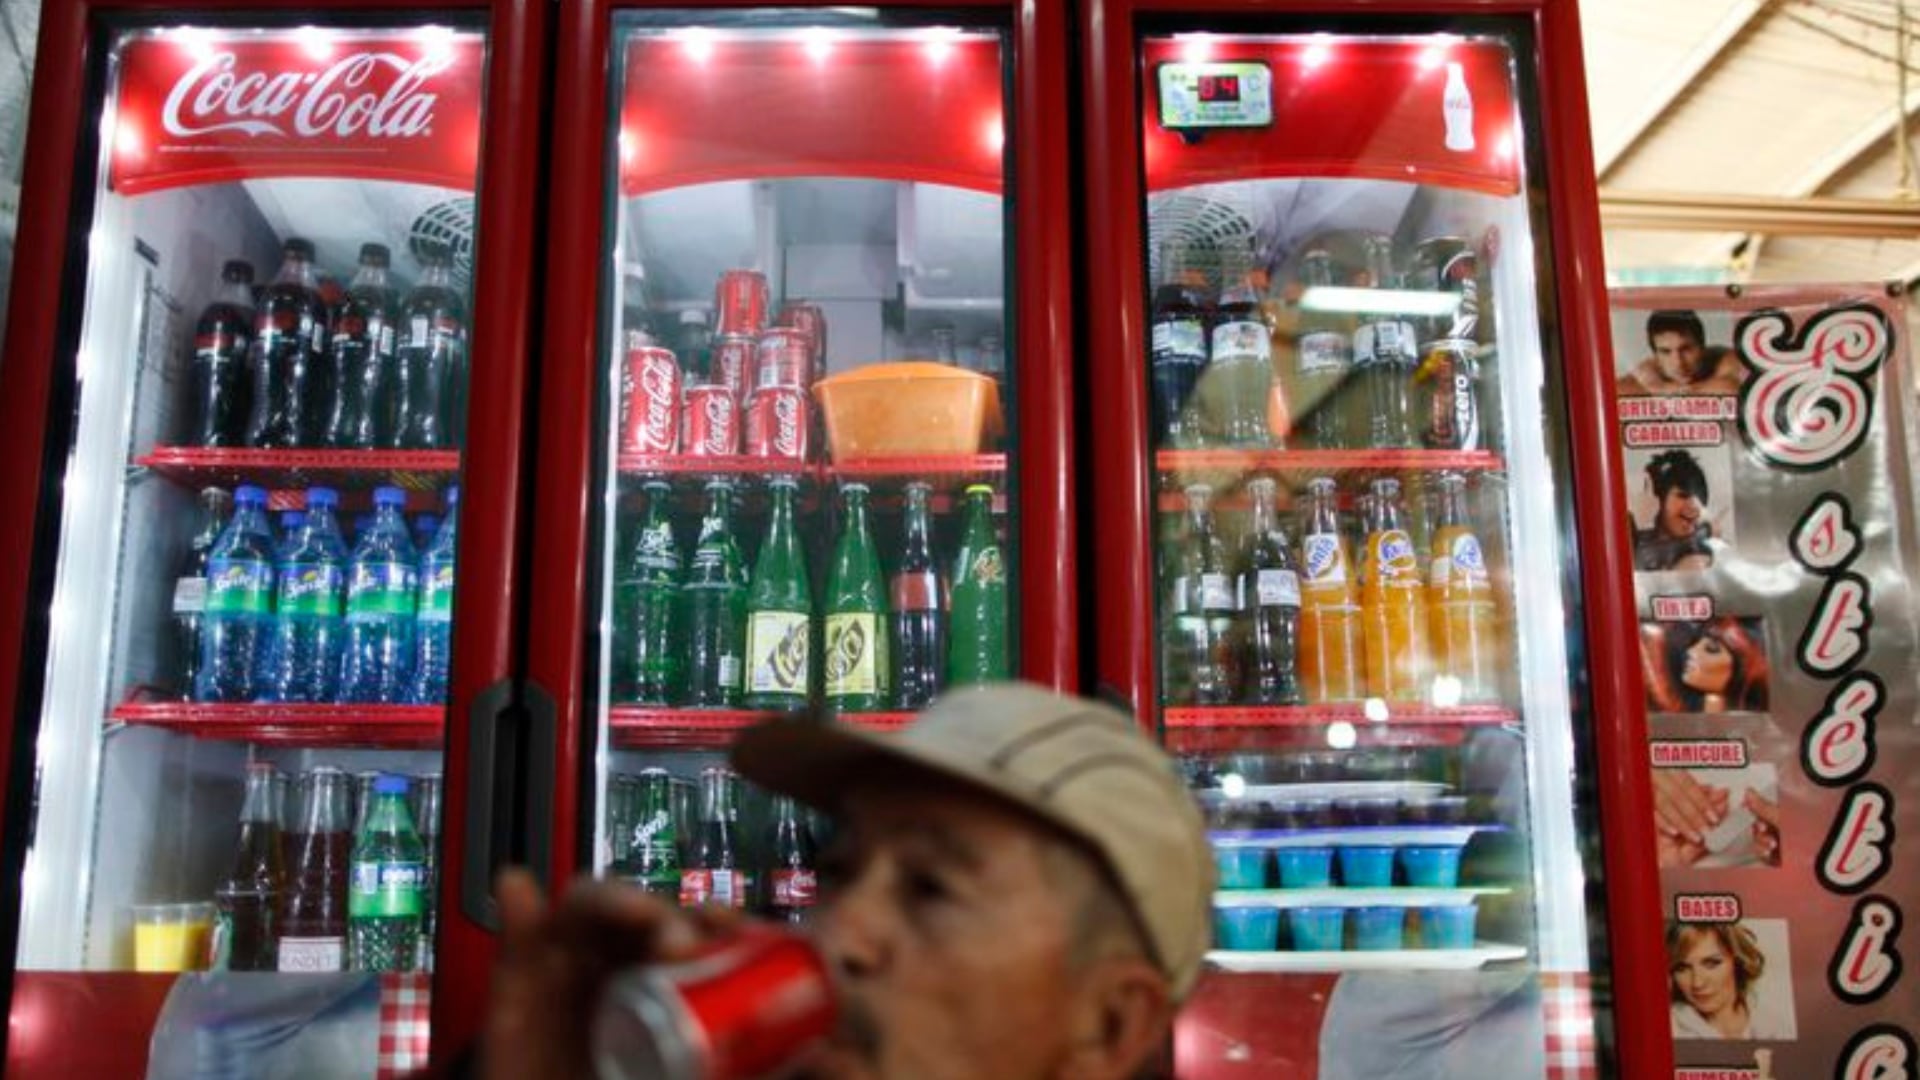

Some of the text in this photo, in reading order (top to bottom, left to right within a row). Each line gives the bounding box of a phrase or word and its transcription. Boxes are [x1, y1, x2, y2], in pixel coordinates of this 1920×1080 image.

[162, 51, 450, 138] Coca-Cola
[1627, 425, 1720, 443] CABALLERO
[1652, 743, 1743, 762] MANICURE
[1679, 899, 1736, 918] BASES
